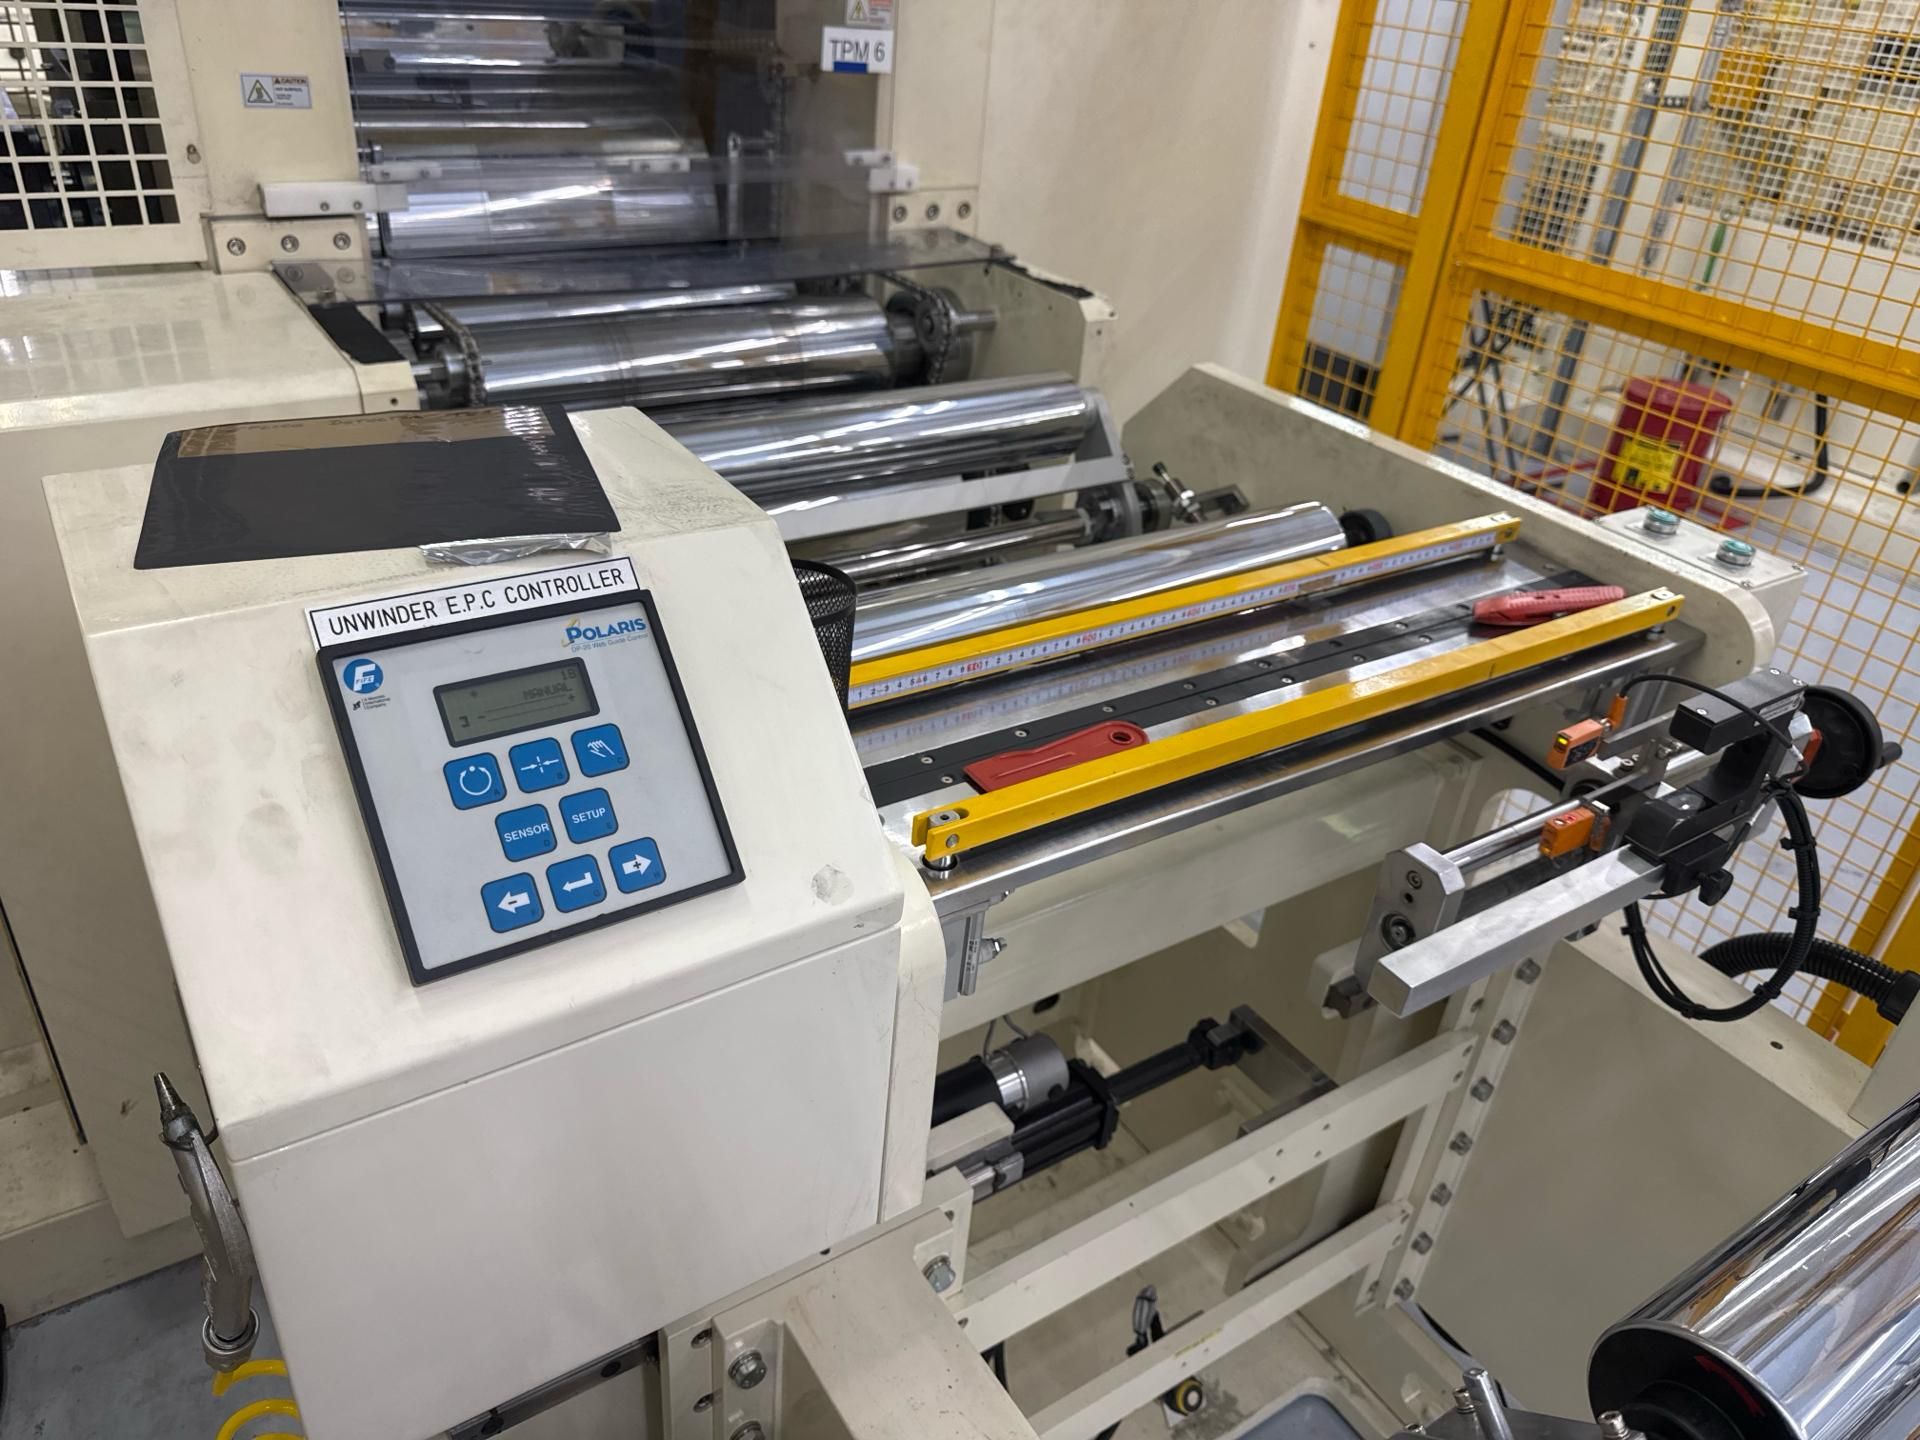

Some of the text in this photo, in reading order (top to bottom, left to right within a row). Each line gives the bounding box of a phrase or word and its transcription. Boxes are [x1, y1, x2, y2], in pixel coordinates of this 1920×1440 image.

[829, 39, 886, 63] TPM 6
[328, 568, 625, 636] UNWINDER E.P.C CONTROLLER
[565, 618, 647, 643] POLARIS
[522, 682, 573, 701] MANUAL
[571, 807, 606, 824] SETUP
[503, 822, 550, 843] SENSOR
